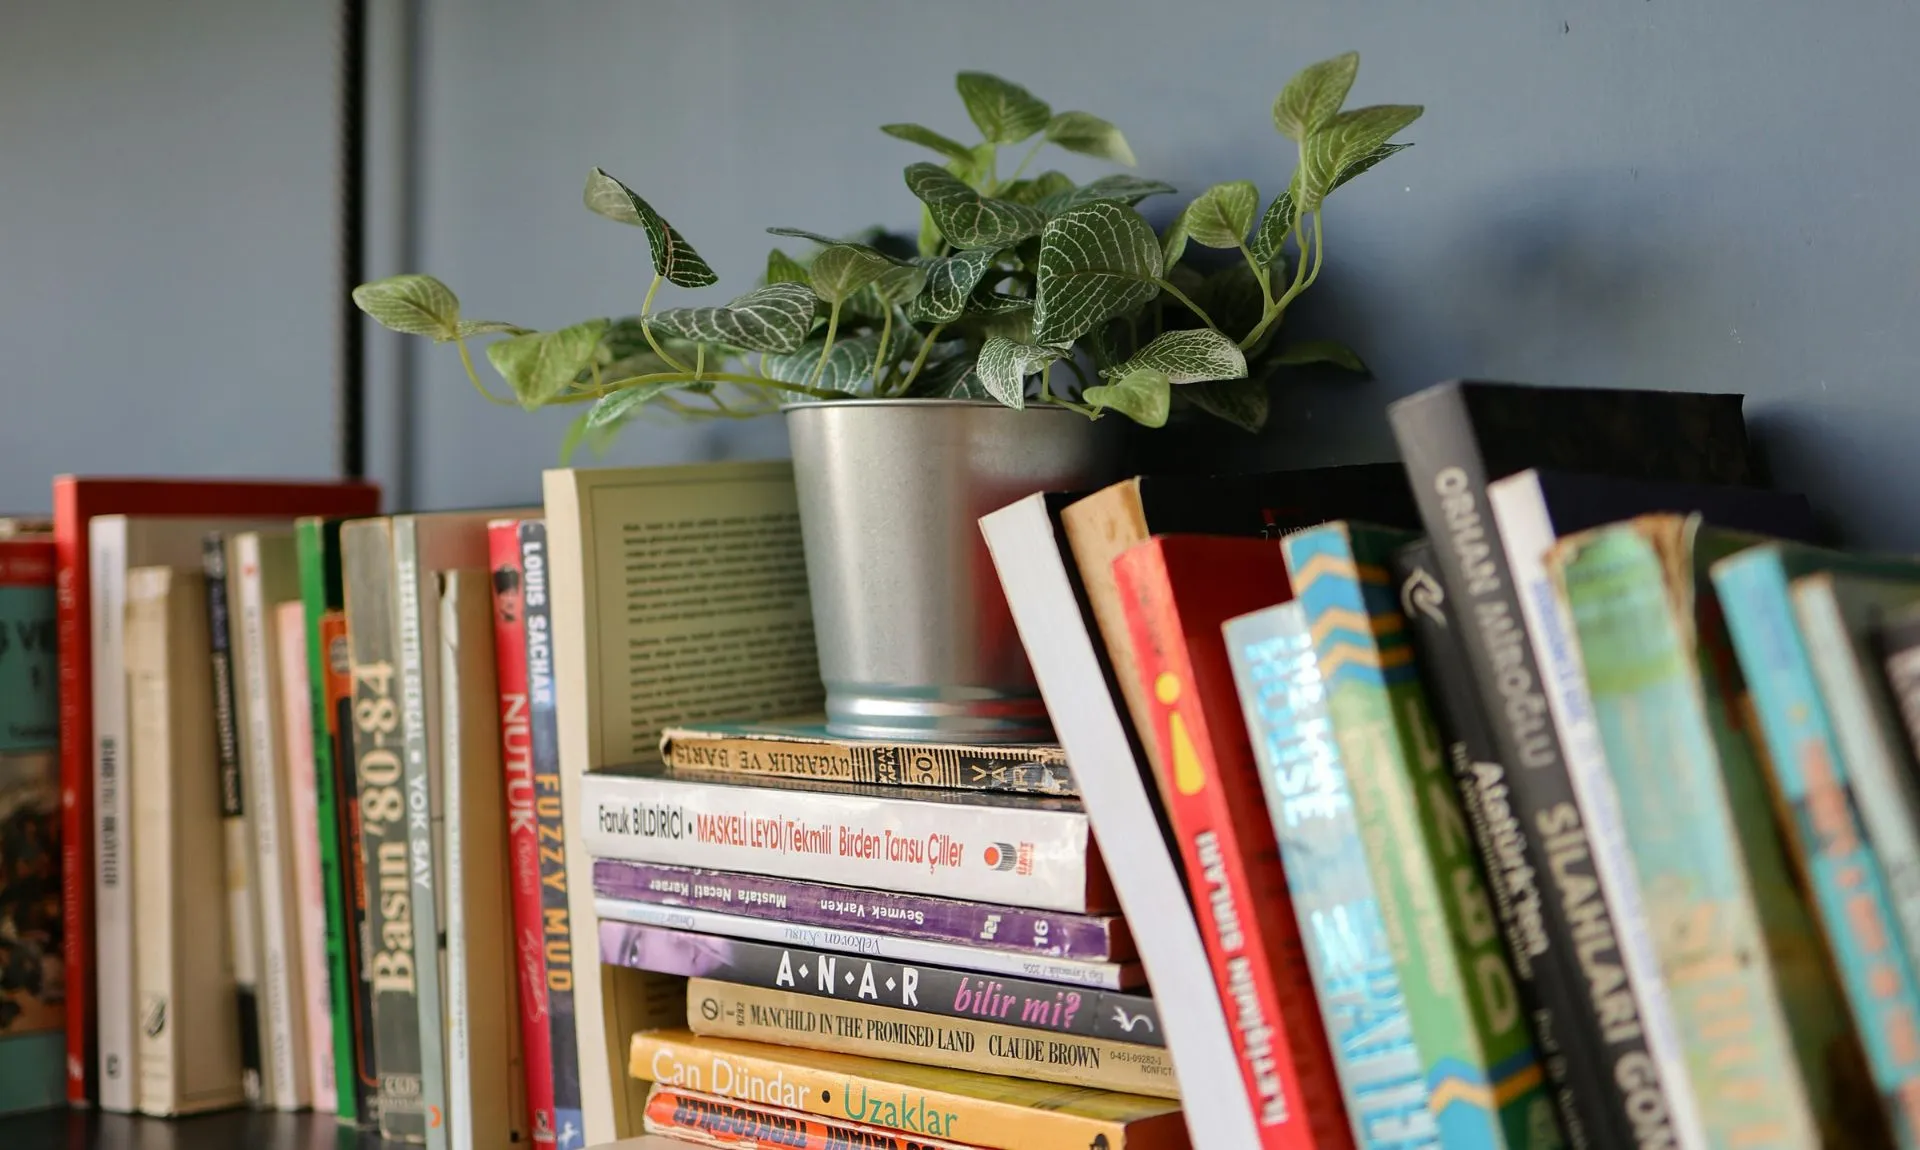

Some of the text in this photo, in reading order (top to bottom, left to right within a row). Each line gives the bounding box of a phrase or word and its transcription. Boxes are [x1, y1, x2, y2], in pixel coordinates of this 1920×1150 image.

[354, 659, 404, 837] '80-84
[501, 691, 537, 835] NUTUK
[740, 750, 761, 769] VE
[768, 751, 850, 777] UYGARLIK
[1245, 636, 1304, 828] HOUSE
[1434, 466, 1500, 597] ORHAN
[1536, 800, 1640, 1045] SİLAHLARI
[409, 774, 426, 826] YOK
[522, 540, 576, 994] LOUIS SACHAR FUZZY MUD
[413, 831, 431, 891] SAY
[598, 804, 630, 835] Faruk
[633, 801, 684, 840] BİLDİRİCİ
[696, 809, 748, 848] MASKELİ
[838, 825, 881, 861] Birden
[884, 829, 923, 863] Tansu
[927, 832, 964, 875] Çiller
[1468, 757, 1551, 958] Atatürk'ten
[373, 841, 416, 996] Basın
[694, 882, 732, 903] Necati
[738, 887, 787, 909] Mustafa
[819, 898, 866, 920] Varken
[871, 903, 925, 926] Sevmek
[1195, 828, 1244, 951] SIRLARI
[1033, 919, 1050, 946] 16
[953, 975, 1017, 1019] bilir
[1020, 990, 1082, 1030] mi?
[749, 1003, 816, 1033] MANCHILD
[818, 1013, 834, 1034] IN
[835, 1015, 864, 1039] THE
[866, 1017, 934, 1049] PROMISED
[936, 1029, 975, 1054] LAND
[988, 1033, 1045, 1063] CLAUDE
[1048, 1046, 1101, 1071] BROWN
[651, 1047, 959, 1138] Can Dündar Uzaklar
